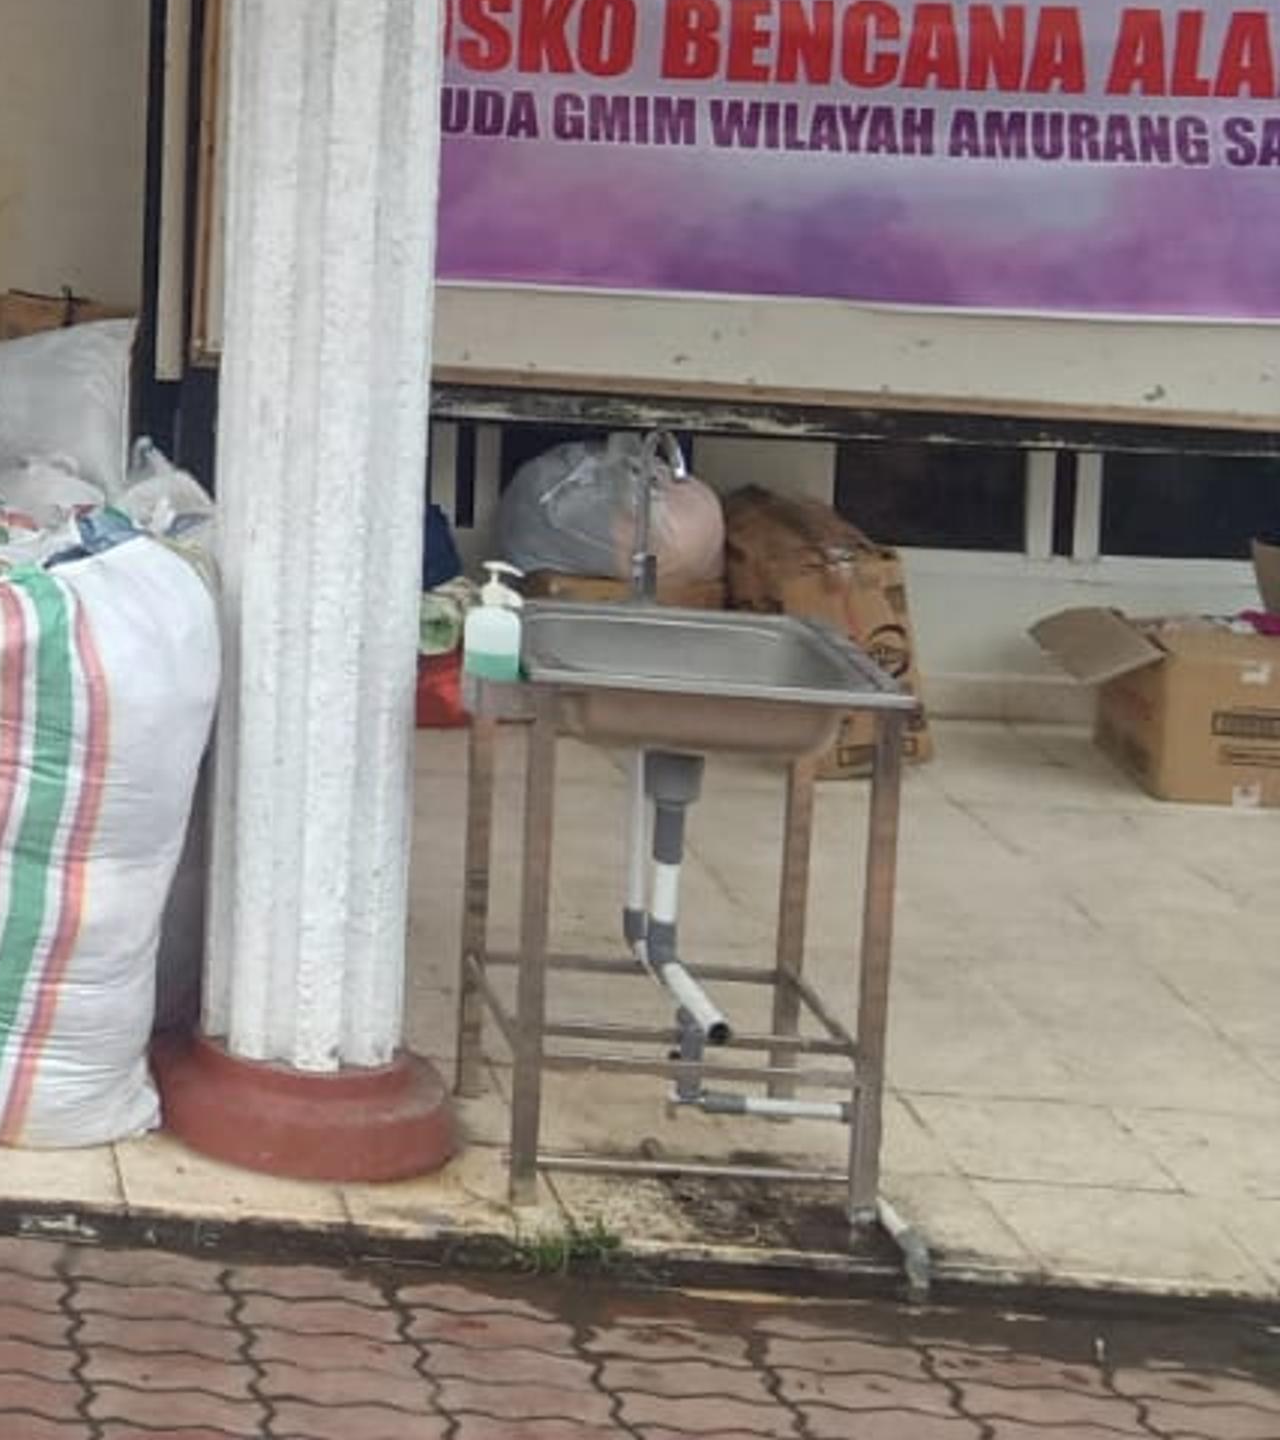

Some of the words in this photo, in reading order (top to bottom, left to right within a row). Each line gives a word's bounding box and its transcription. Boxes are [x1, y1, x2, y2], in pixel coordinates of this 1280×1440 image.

[1104, 9, 1280, 99] ALA
[553, 93, 696, 146] GMIM
[710, 99, 935, 156] WILAYAH
[948, 108, 1209, 165] AMURANG
